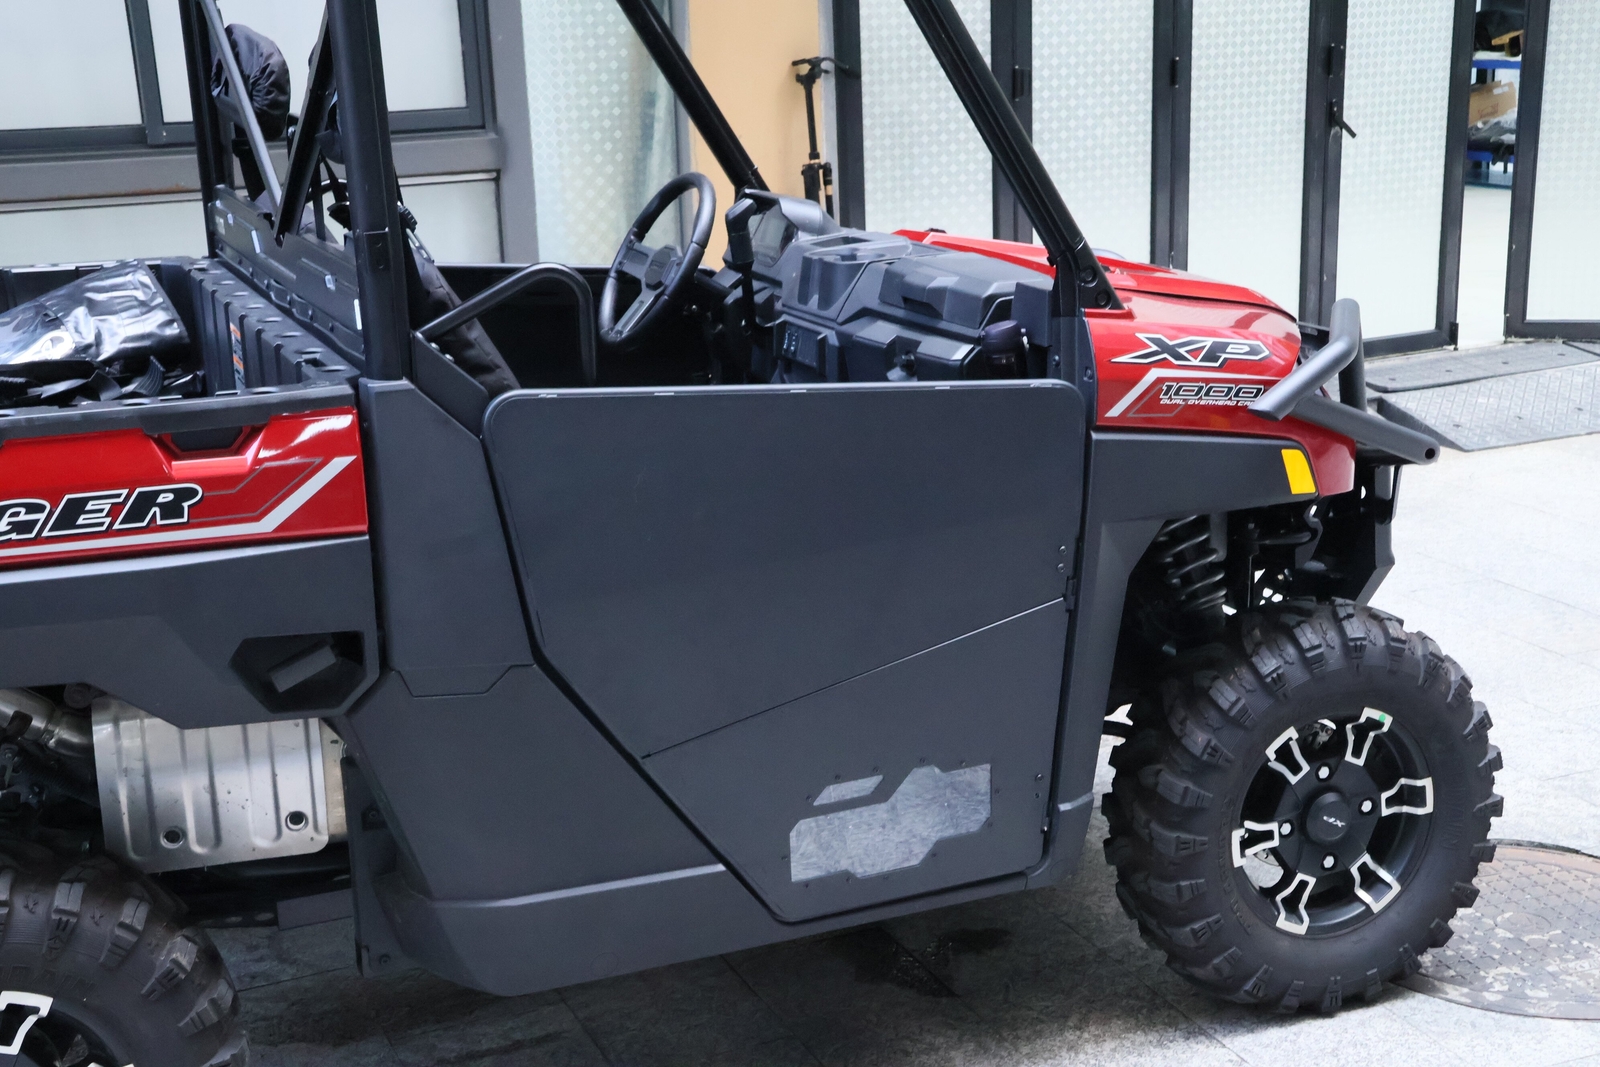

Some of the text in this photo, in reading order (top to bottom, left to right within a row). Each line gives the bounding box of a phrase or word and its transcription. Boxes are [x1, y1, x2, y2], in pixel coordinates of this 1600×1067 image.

[1111, 333, 1272, 368] XP
[1160, 382, 1265, 399] 1000
[0, 482, 204, 541] GER
